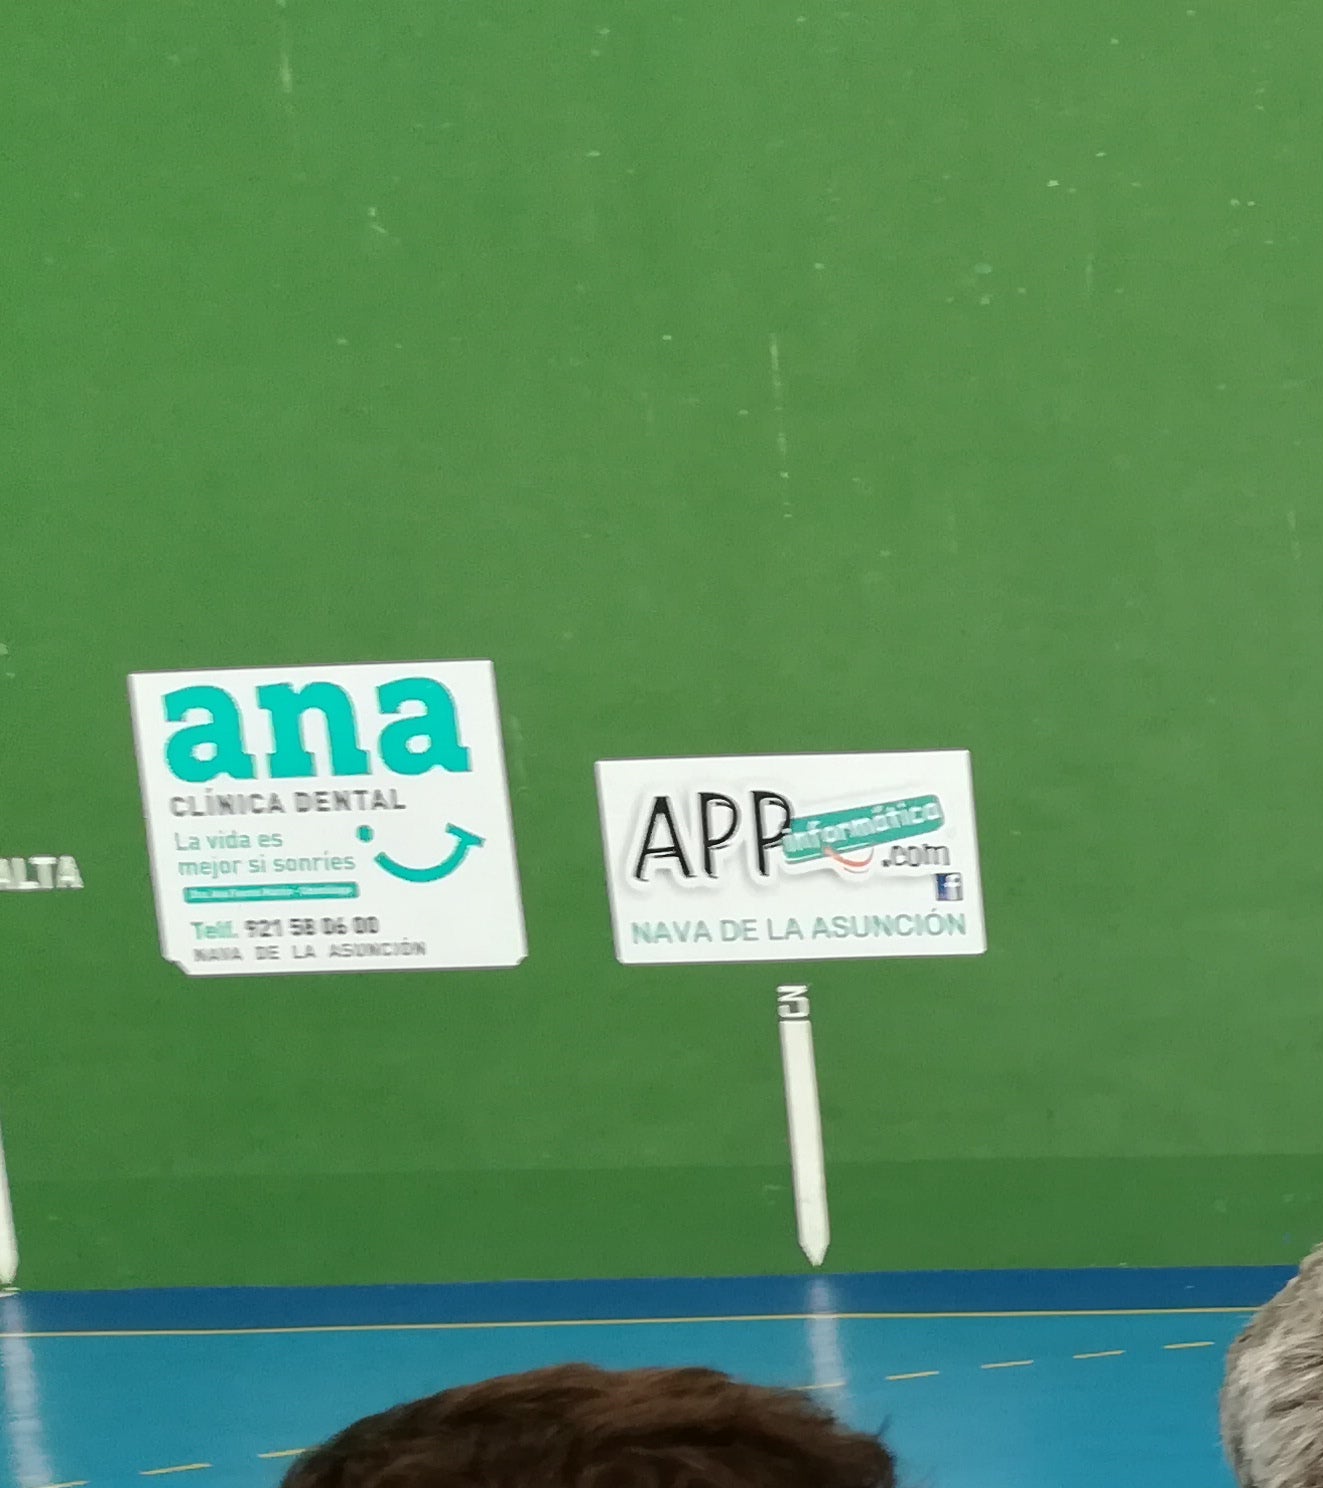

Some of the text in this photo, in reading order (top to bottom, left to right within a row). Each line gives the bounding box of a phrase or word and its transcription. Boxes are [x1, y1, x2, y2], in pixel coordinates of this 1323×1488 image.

[162, 676, 471, 783] ana
[170, 786, 406, 817] CLÍNICA DENTAL
[174, 830, 283, 851] La vida es
[634, 791, 794, 882] APP
[178, 855, 242, 879] mejor
[249, 854, 267, 873] si
[245, 919, 282, 937] 921
[290, 918, 315, 936] 58
[321, 917, 347, 935] 06
[353, 916, 378, 934] 00
[631, 909, 967, 944] NAVA DE LA ASUNCIÓN
[194, 936, 426, 961] NAVA DE LA ASUNCIÓN
[777, 985, 808, 1017] 3
